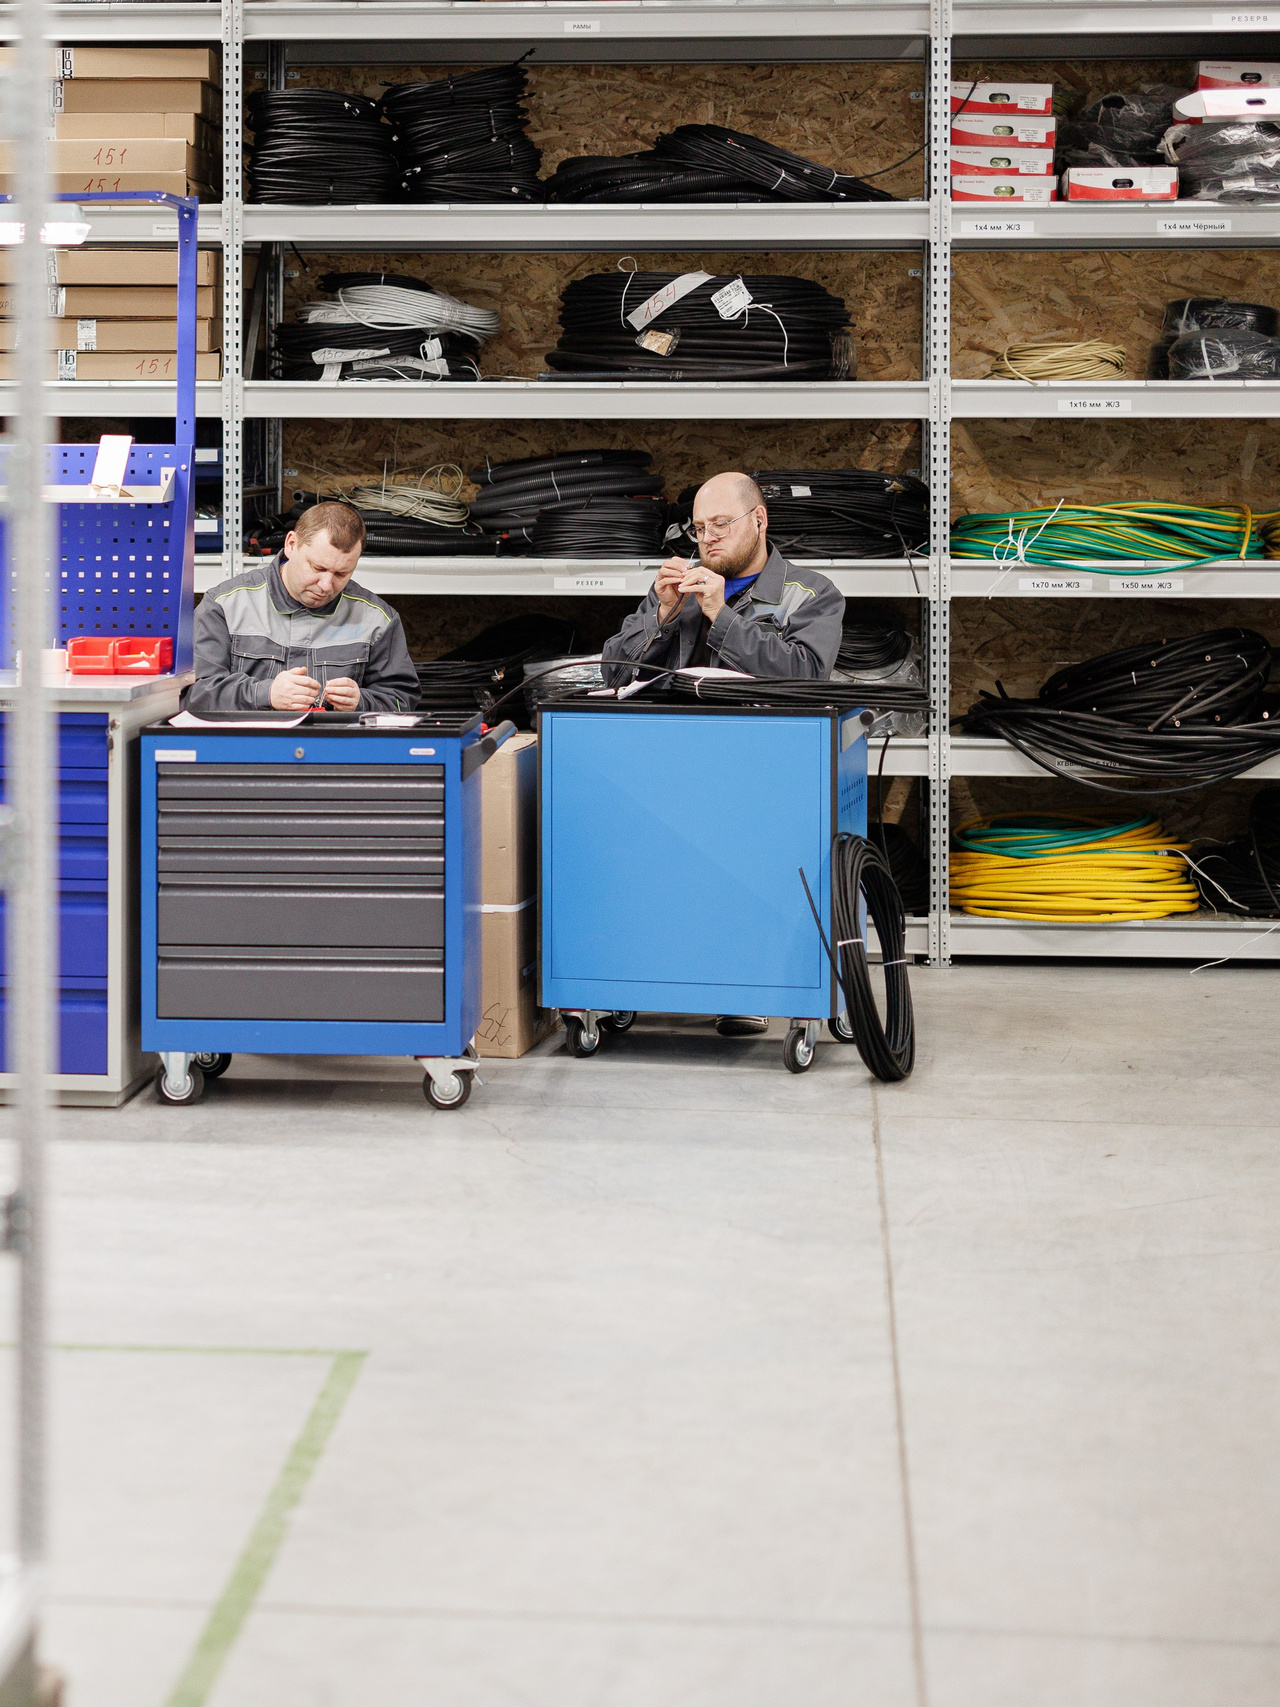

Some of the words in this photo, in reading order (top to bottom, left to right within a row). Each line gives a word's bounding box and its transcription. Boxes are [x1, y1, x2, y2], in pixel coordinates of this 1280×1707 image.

[93, 147, 128, 166] 151
[83, 177, 122, 193] 151
[1193, 222, 1225, 231] Чёрный
[643, 283, 677, 319] 154
[135, 357, 172, 375] 151
